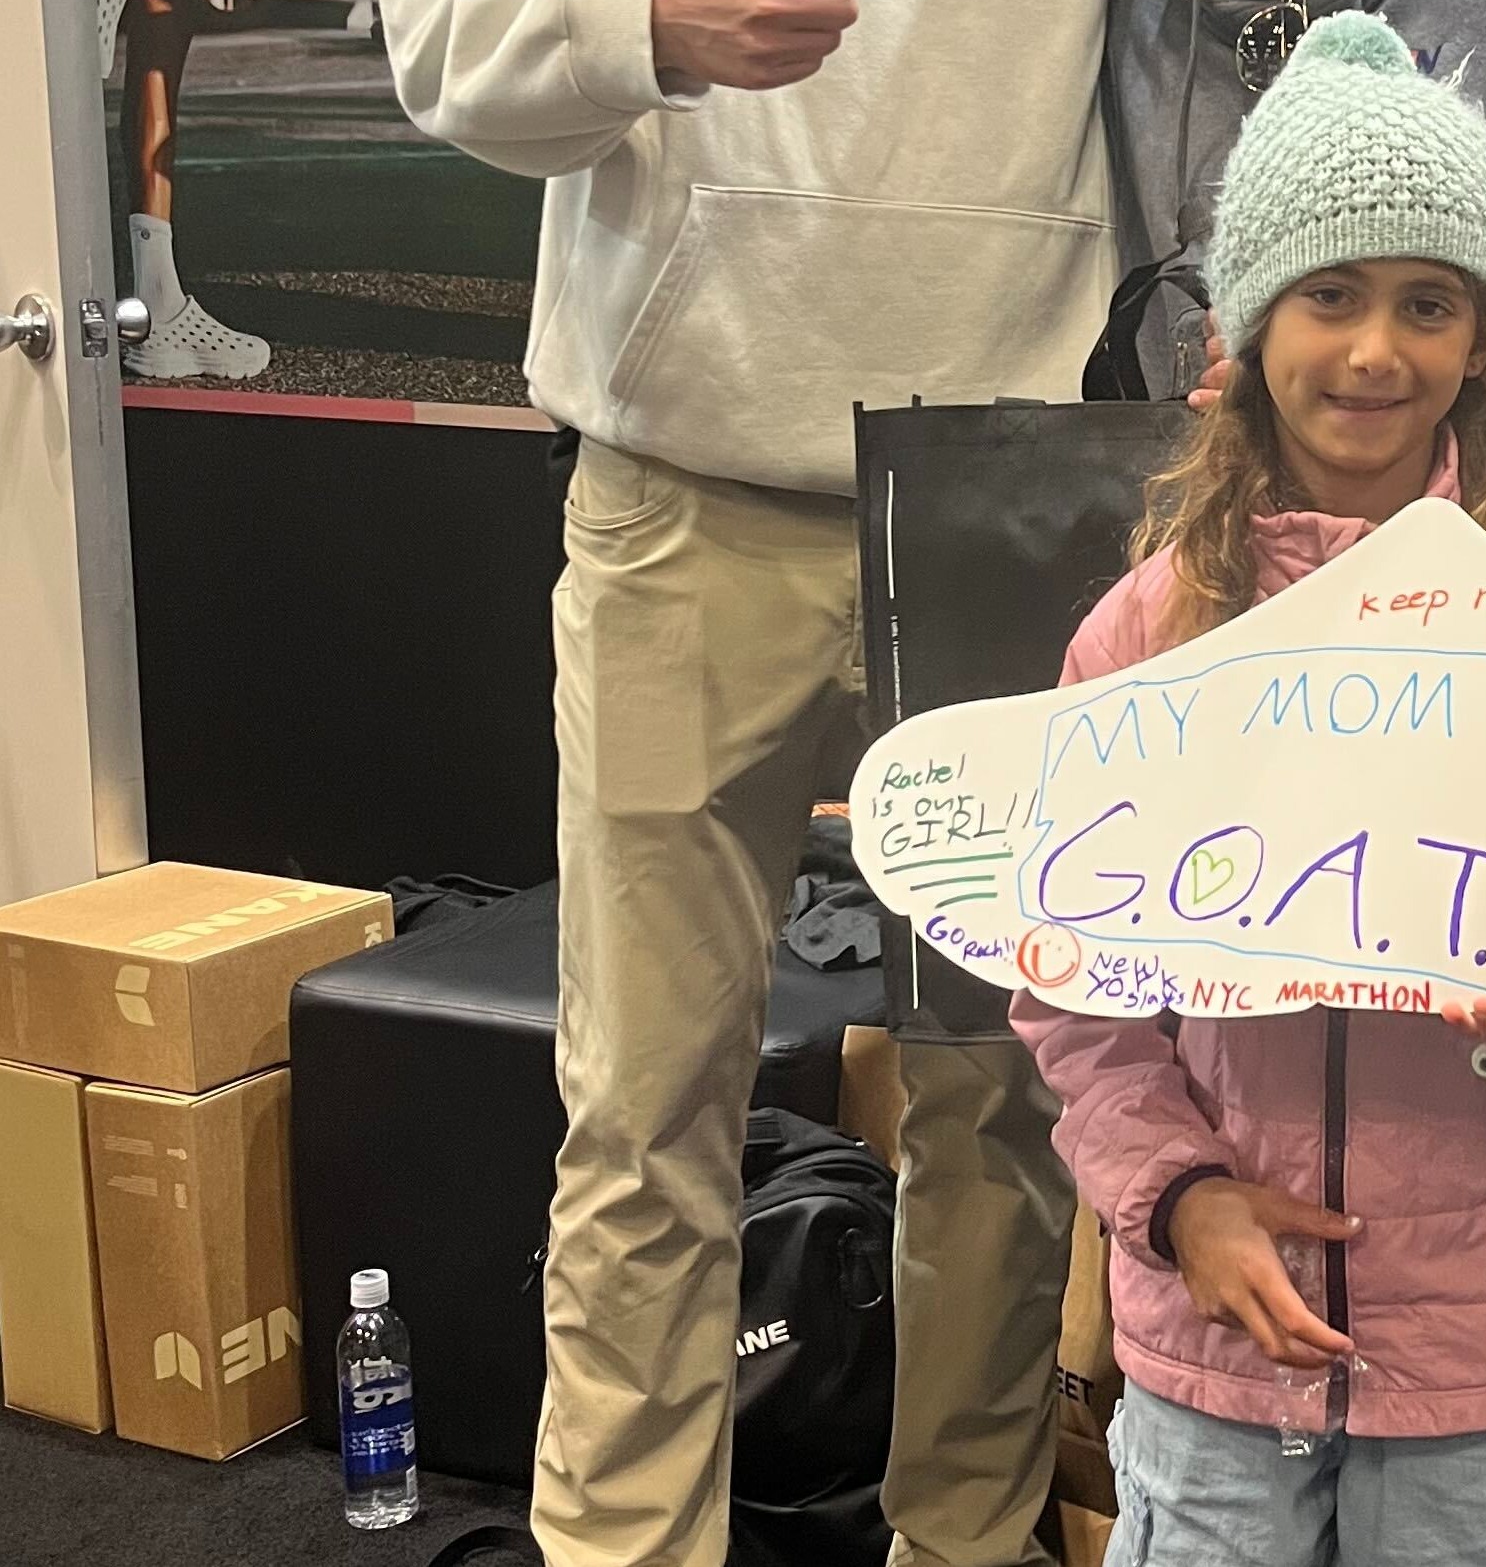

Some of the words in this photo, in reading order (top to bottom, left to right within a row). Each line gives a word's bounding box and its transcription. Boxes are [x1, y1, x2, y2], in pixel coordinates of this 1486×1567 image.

[1050, 688, 1201, 779] MY
[1242, 672, 1453, 738] MOM
[880, 753, 966, 793] Rachel
[915, 795, 975, 817] our
[1191, 977, 1253, 1014] NYC
[1275, 979, 1431, 1014] MARATHON
